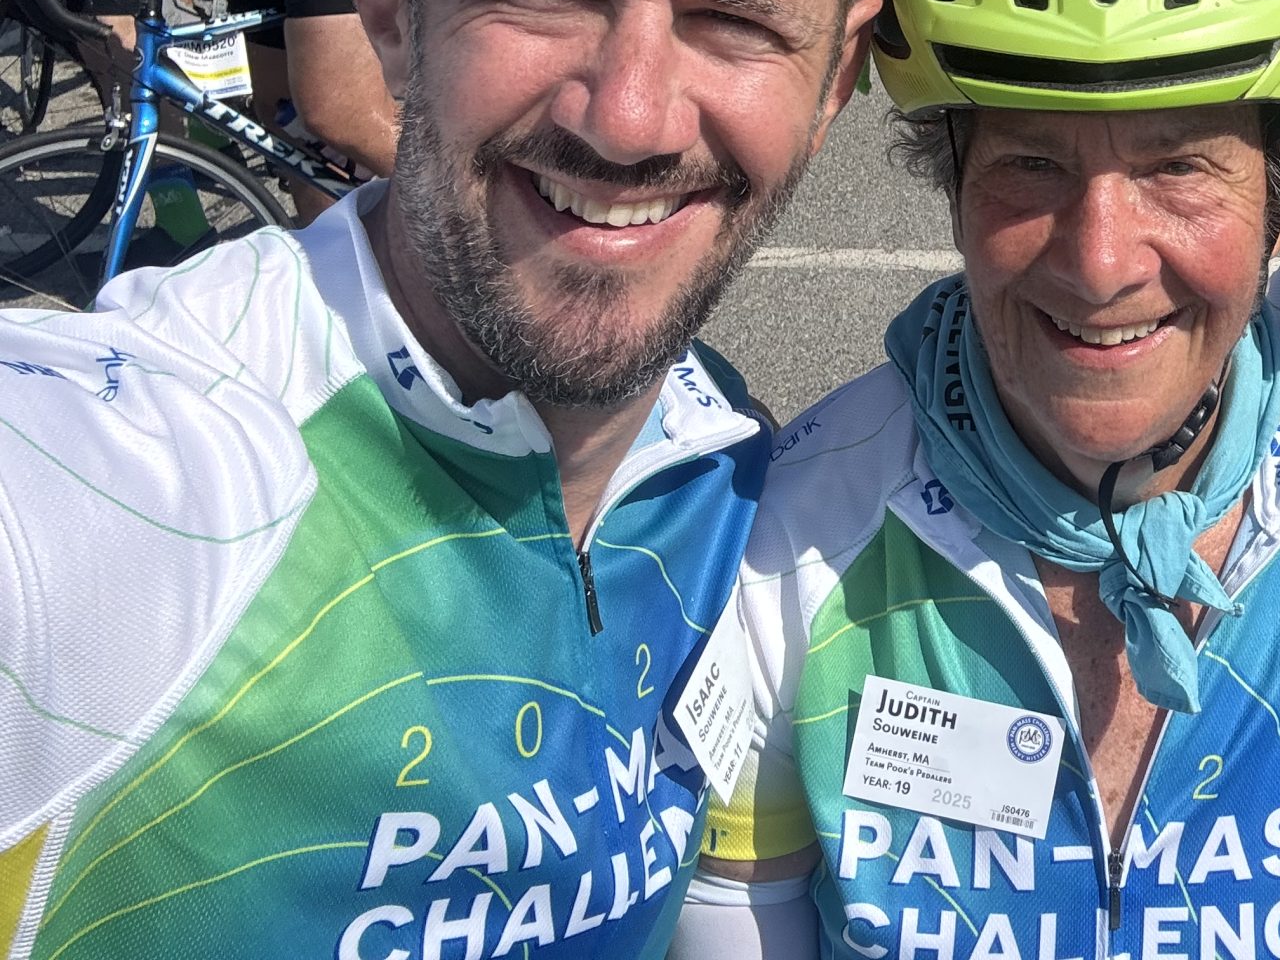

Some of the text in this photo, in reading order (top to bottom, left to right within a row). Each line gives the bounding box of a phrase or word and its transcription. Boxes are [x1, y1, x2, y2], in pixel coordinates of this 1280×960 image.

[685, 661, 721, 726] ISAAC
[905, 690, 941, 707] CAPTAIN
[395, 725, 433, 787] 2
[635, 643, 655, 699] 2
[698, 683, 728, 744] SOUWEINE
[725, 705, 735, 719] MA
[875, 689, 958, 730] JUDITH
[872, 718, 939, 745] SOUWEINE
[735, 741, 744, 760] 11
[866, 742, 930, 766] AMHERST, MA
[865, 757, 953, 785] TEAM POOK'S PEDALERS
[1193, 754, 1224, 800] 2
[862, 774, 911, 796] YEAR: 19
[931, 788, 972, 810] 2025
[1001, 804, 1031, 819] JS0476
